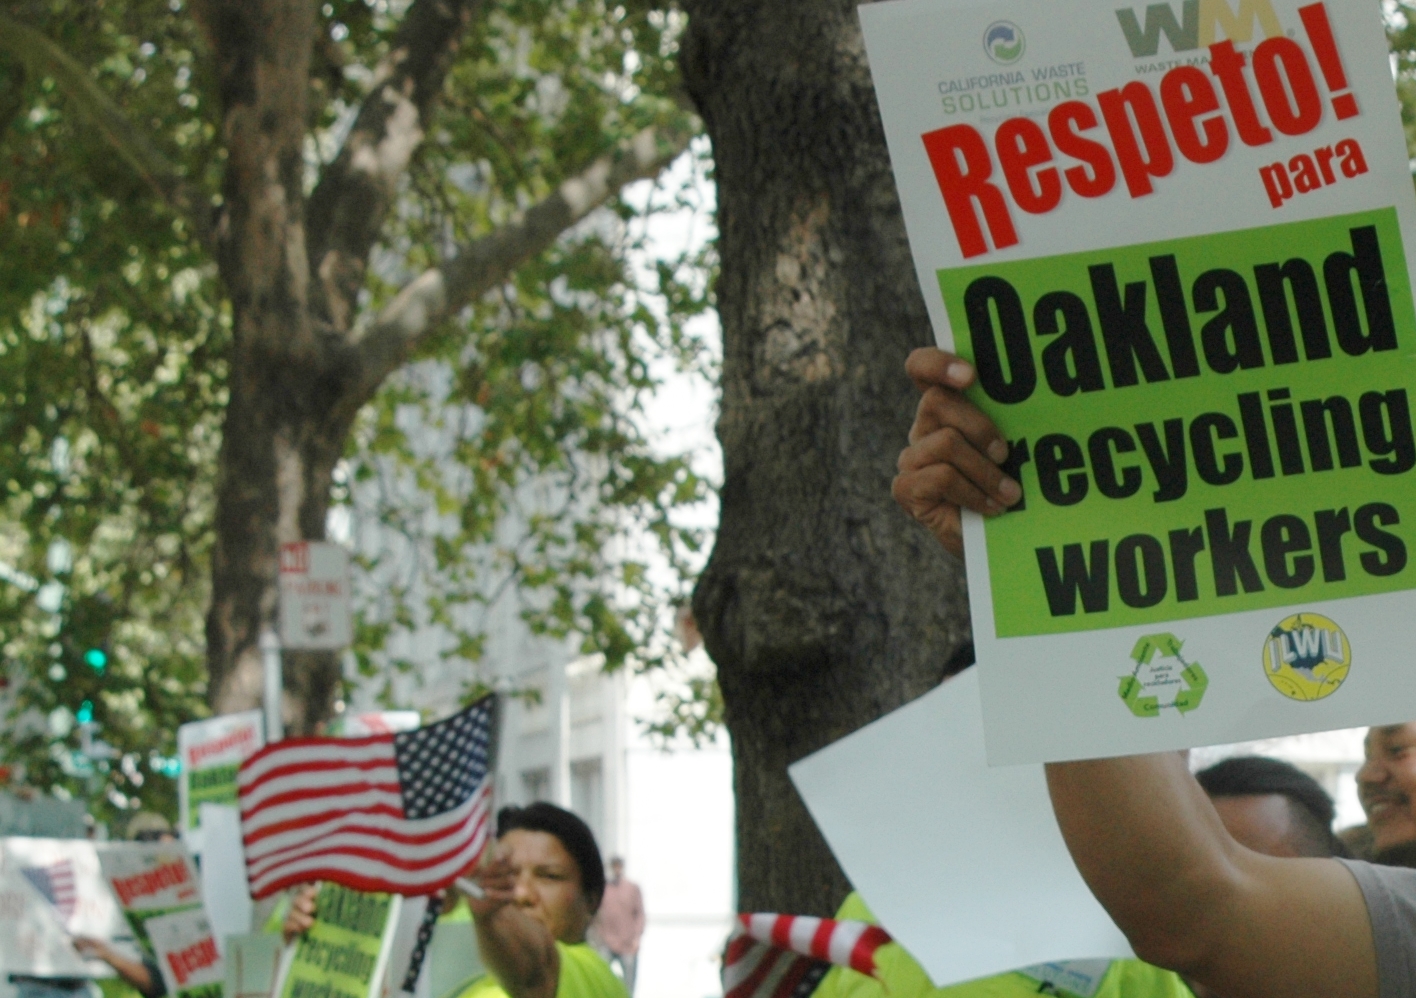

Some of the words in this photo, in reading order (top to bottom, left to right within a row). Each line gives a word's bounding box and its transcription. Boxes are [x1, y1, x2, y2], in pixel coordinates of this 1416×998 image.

[938, 71, 1026, 94] CALIFORNIA
[1031, 61, 1086, 81] WASTE
[941, 77, 1090, 114] SOLUTIONS
[921, 2, 1360, 259] Respeto!
[1258, 137, 1369, 208] para
[963, 224, 1399, 404] Oakland
[1034, 501, 1408, 617] workers
[1268, 627, 1345, 672] ILWU
